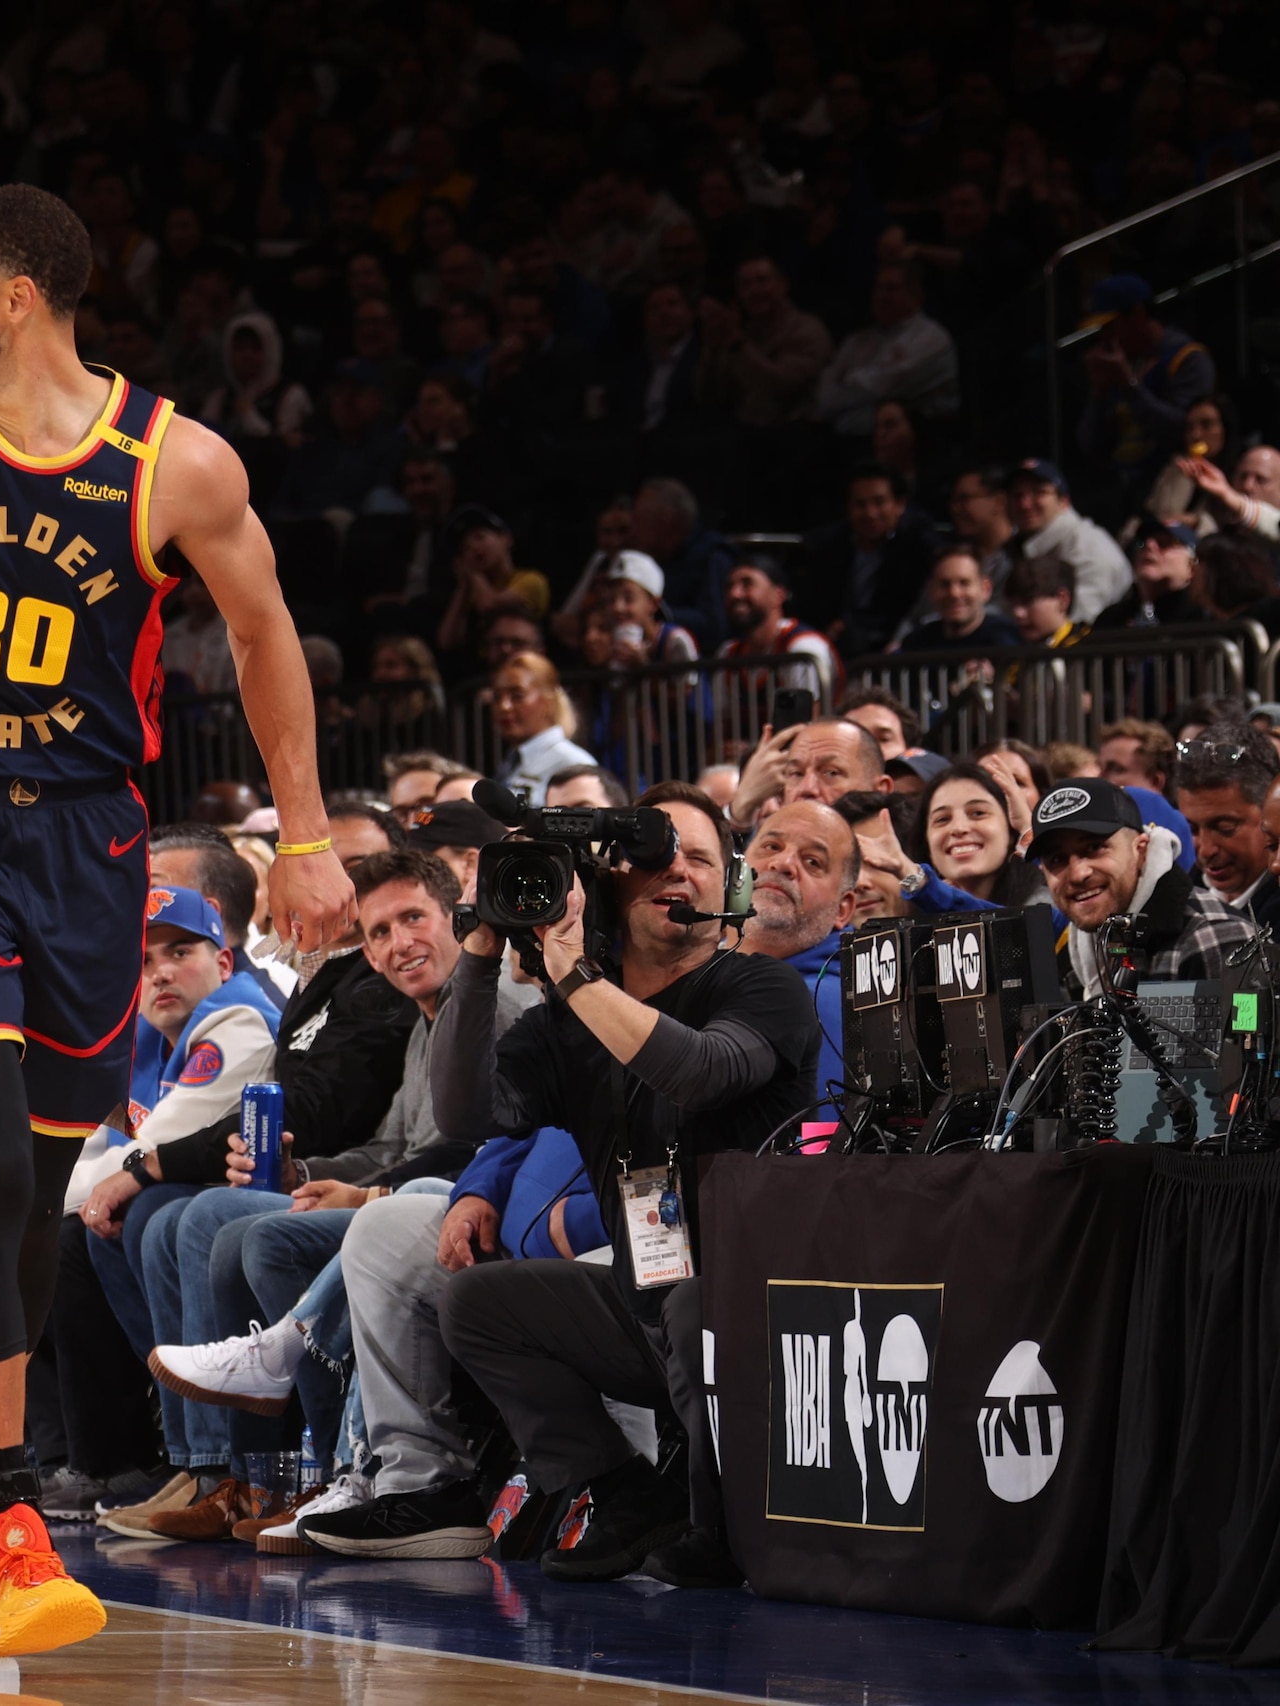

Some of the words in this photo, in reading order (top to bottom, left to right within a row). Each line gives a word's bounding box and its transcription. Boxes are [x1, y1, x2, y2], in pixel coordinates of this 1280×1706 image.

[117, 436, 133, 452] 16
[64, 477, 128, 502] Rakuten
[243, 1099, 251, 1136] YORK
[643, 1268, 679, 1279] BROADCAST
[781, 1333, 831, 1469] NBA
[877, 1380, 928, 1452] TNT
[977, 1394, 1063, 1457] TNT
